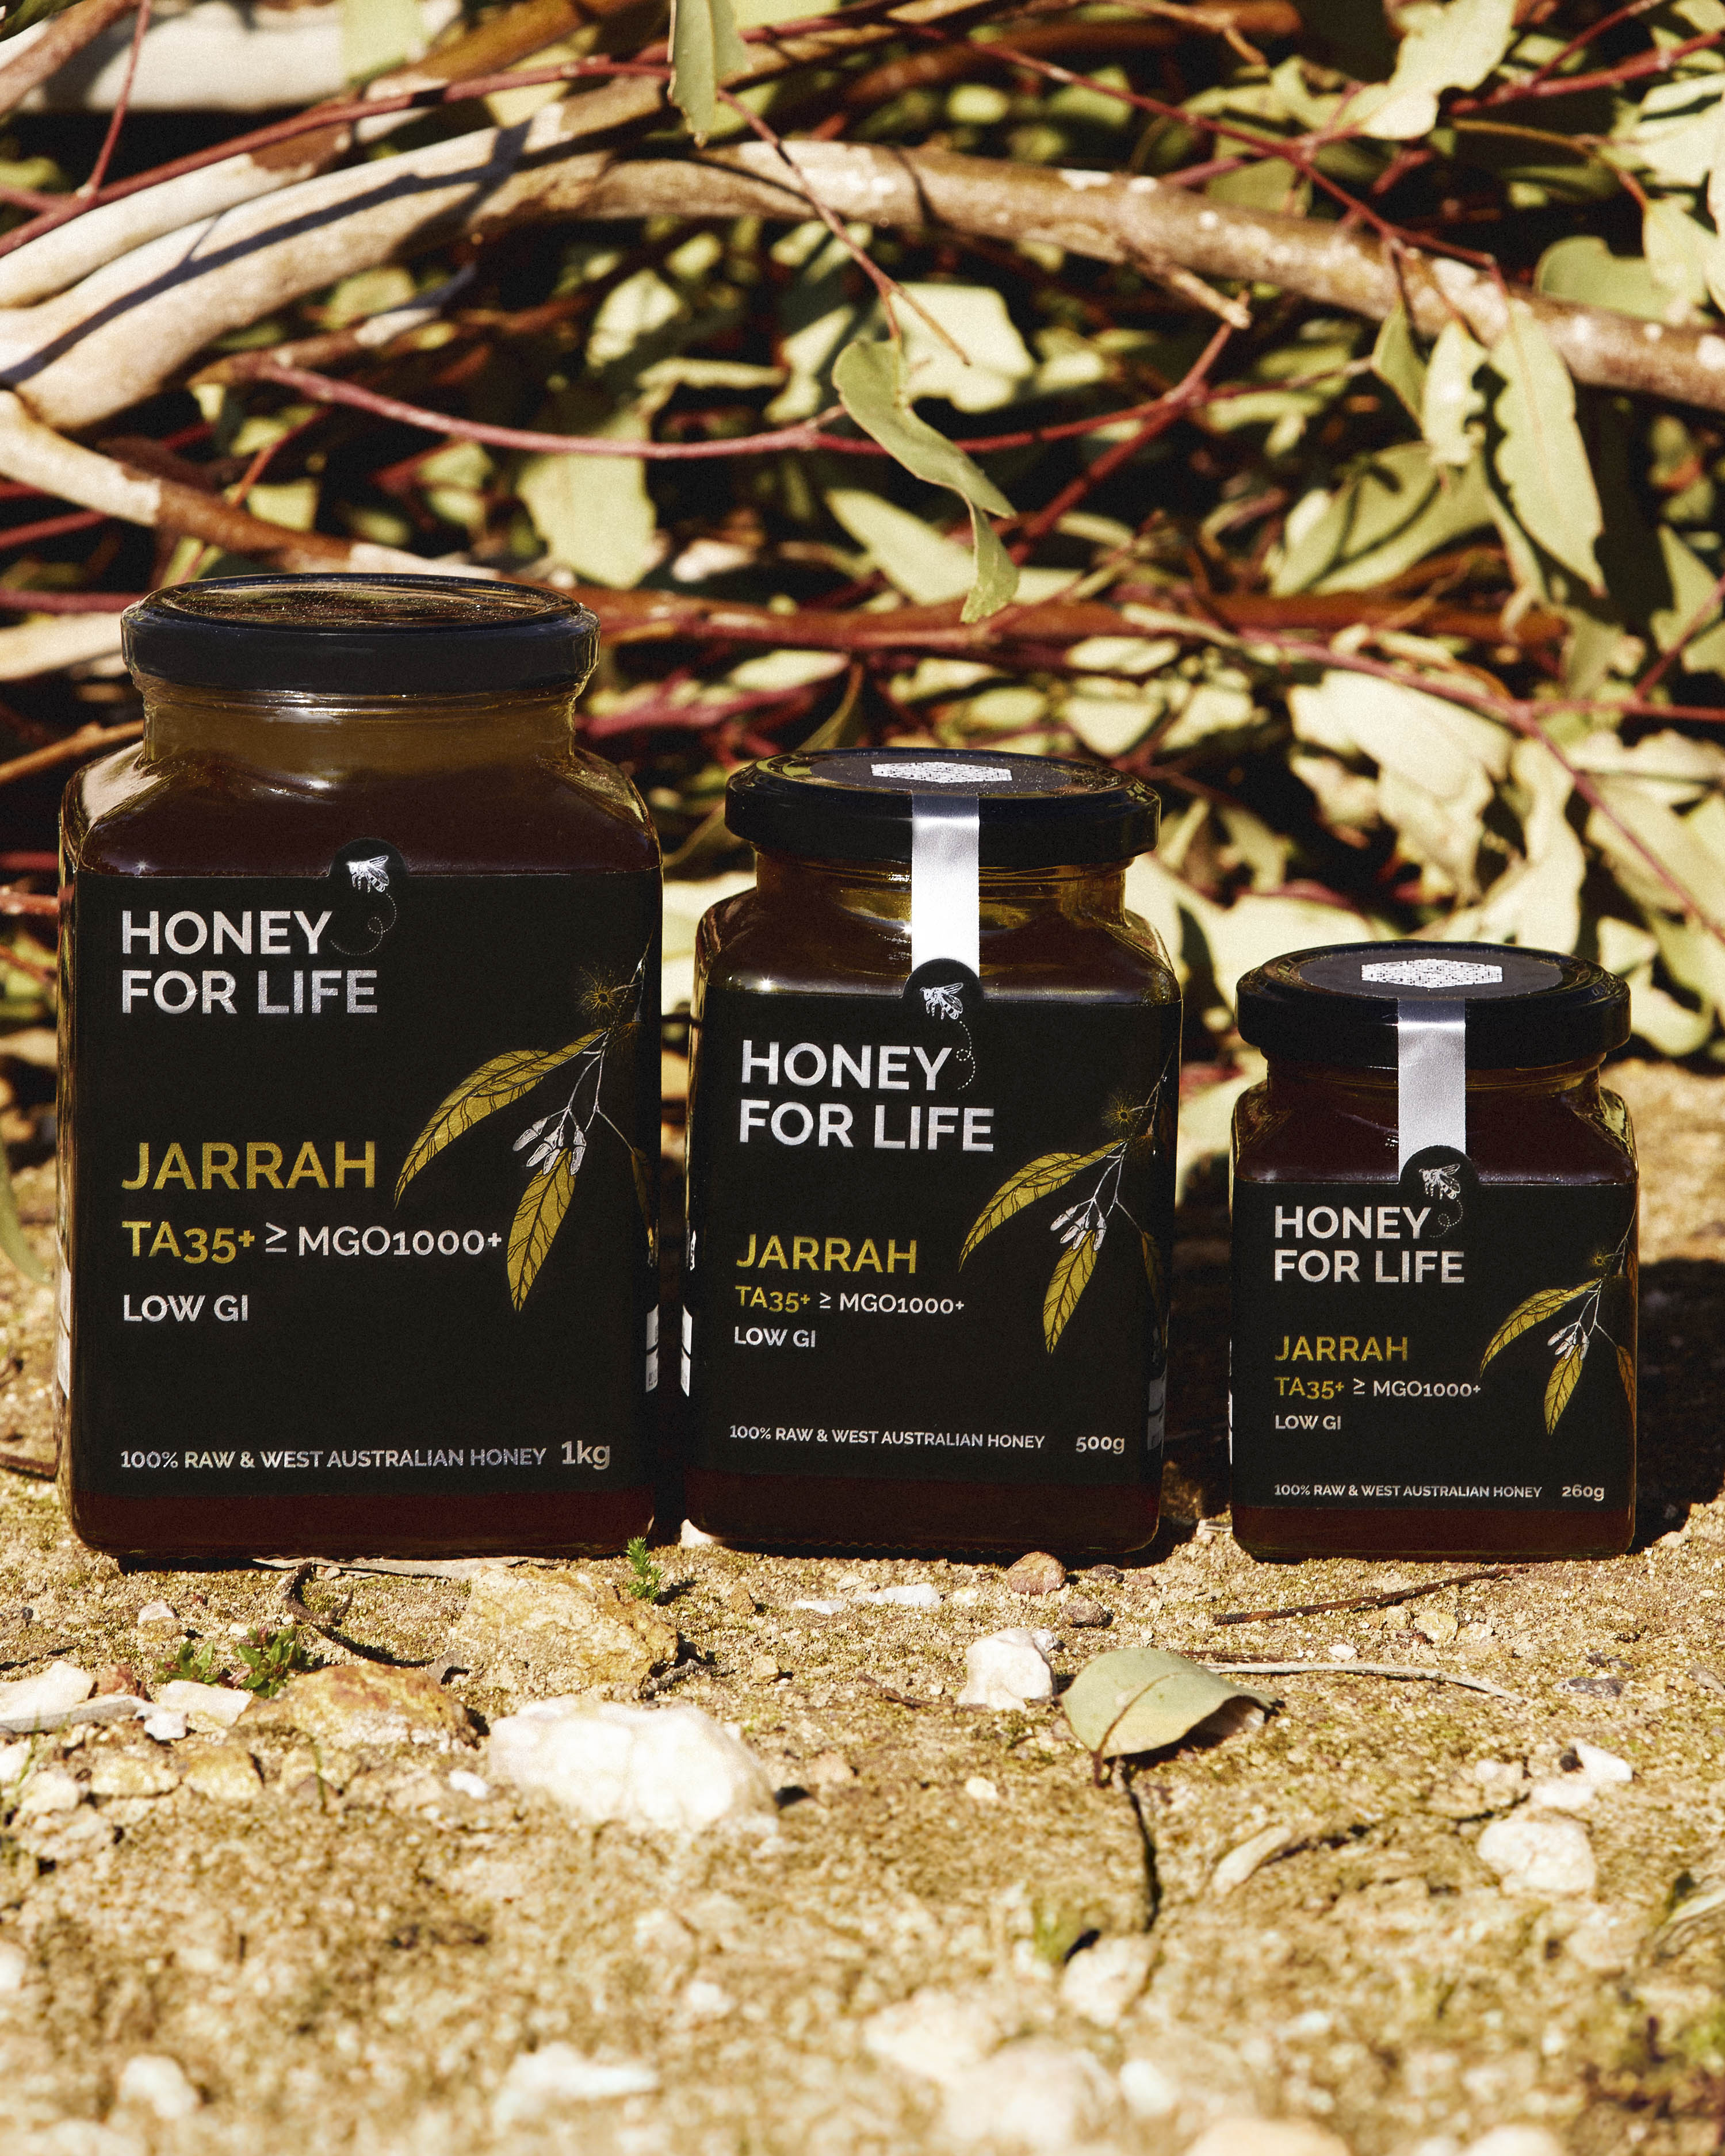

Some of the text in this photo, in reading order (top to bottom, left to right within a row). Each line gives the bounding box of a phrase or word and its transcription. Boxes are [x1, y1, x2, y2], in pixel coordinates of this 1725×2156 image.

[122, 910, 332, 955] HONEY
[122, 969, 378, 1014] FOR LIFE
[741, 1039, 953, 1091] HONEY
[739, 1098, 994, 1152] FOR LIFE
[121, 1141, 376, 1190] JARRAH
[1275, 1205, 1432, 1239] HONEY
[121, 1220, 255, 1264] TA35+
[299, 1226, 502, 1257] MGO1000+
[736, 1234, 917, 1274] JARRAH
[1274, 1249, 1465, 1284] FOR LIFE
[123, 1294, 248, 1322] LOW GI
[735, 1285, 810, 1313] TA35+
[839, 1292, 965, 1314] MGO1000+
[734, 1326, 816, 1348] LOW GI
[1275, 1335, 1407, 1362] JARRAH
[1275, 1377, 1345, 1400] TA35+
[1373, 1380, 1481, 1397] MGO1000+
[730, 1424, 1045, 1449] 100% RAW & WEST AUSTRALIAN HONEY
[1275, 1415, 1341, 1430] LOW GI
[120, 1447, 547, 1469] 100% RAW & WEST AUSTRALIAN HONEY
[561, 1440, 610, 1470] 1kg
[1076, 1435, 1125, 1454] 500g
[1275, 1484, 1543, 1498] 100% RAW & WEST AUSTRALIAN HONEY
[1562, 1484, 1605, 1502] 260g
